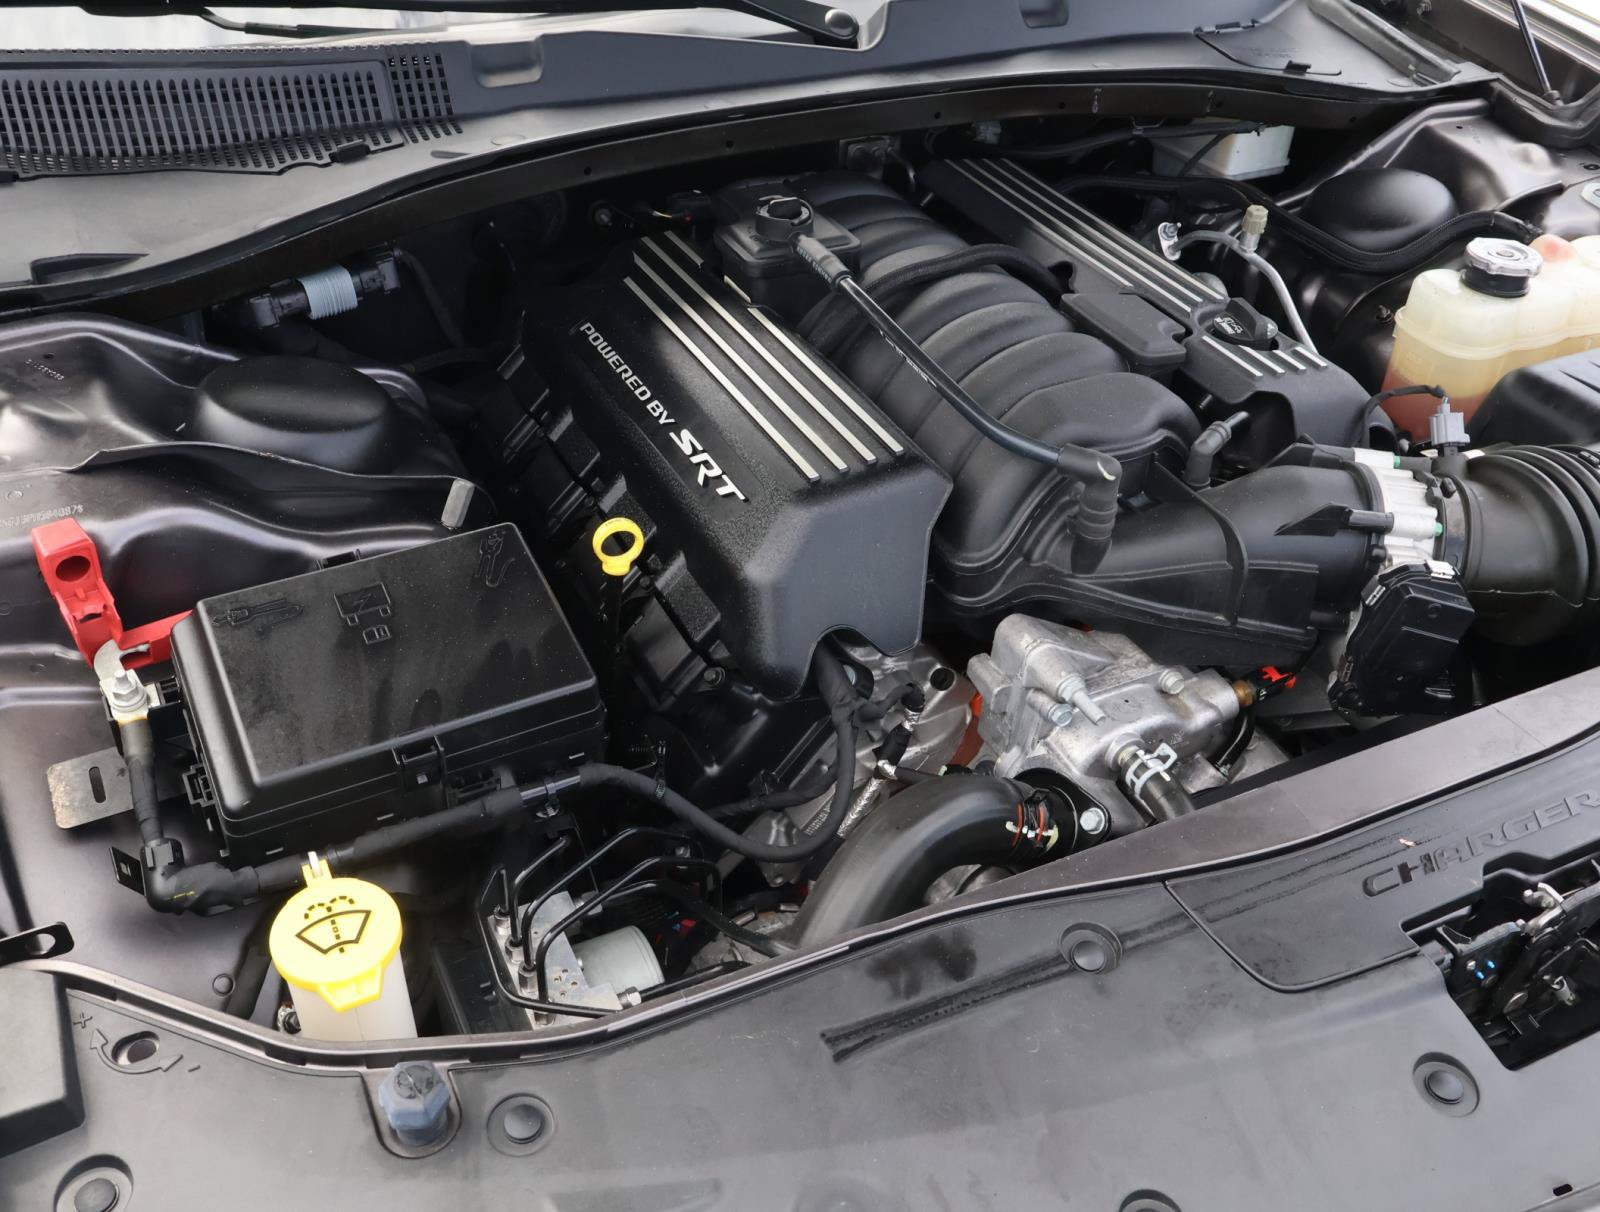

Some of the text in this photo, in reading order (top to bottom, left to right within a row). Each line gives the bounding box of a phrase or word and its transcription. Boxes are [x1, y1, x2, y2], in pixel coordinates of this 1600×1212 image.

[579, 322, 747, 501] POWERED BY SRT
[1361, 789, 1600, 897] CHARGER
